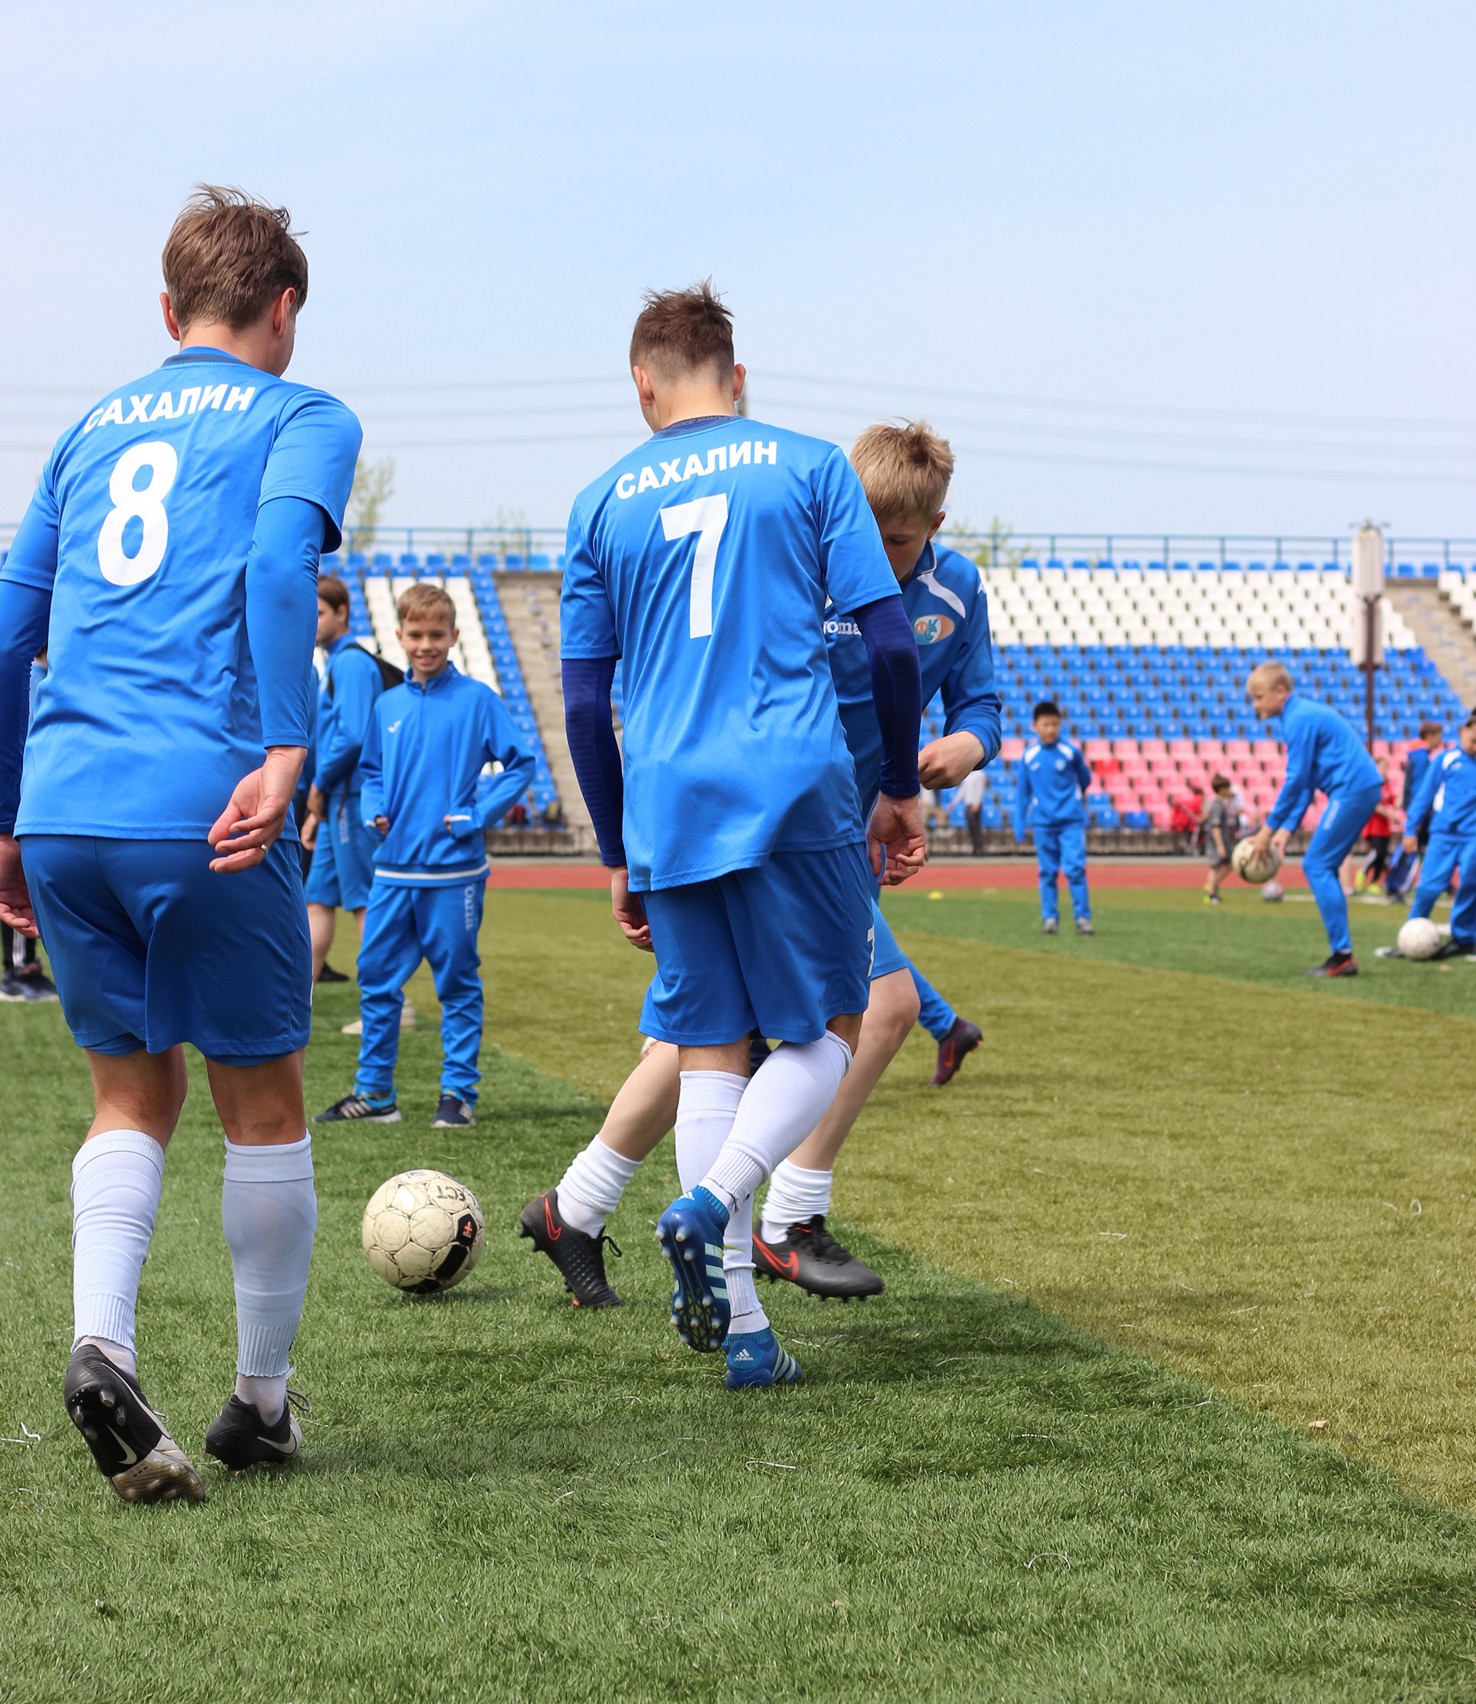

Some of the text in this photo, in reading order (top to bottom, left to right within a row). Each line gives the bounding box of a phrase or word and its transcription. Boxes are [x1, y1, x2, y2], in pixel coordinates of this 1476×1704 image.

[83, 384, 256, 433] САХАЛИН
[98, 441, 178, 586] 8
[615, 441, 777, 499] САХАЛИН
[659, 493, 728, 639] 7
